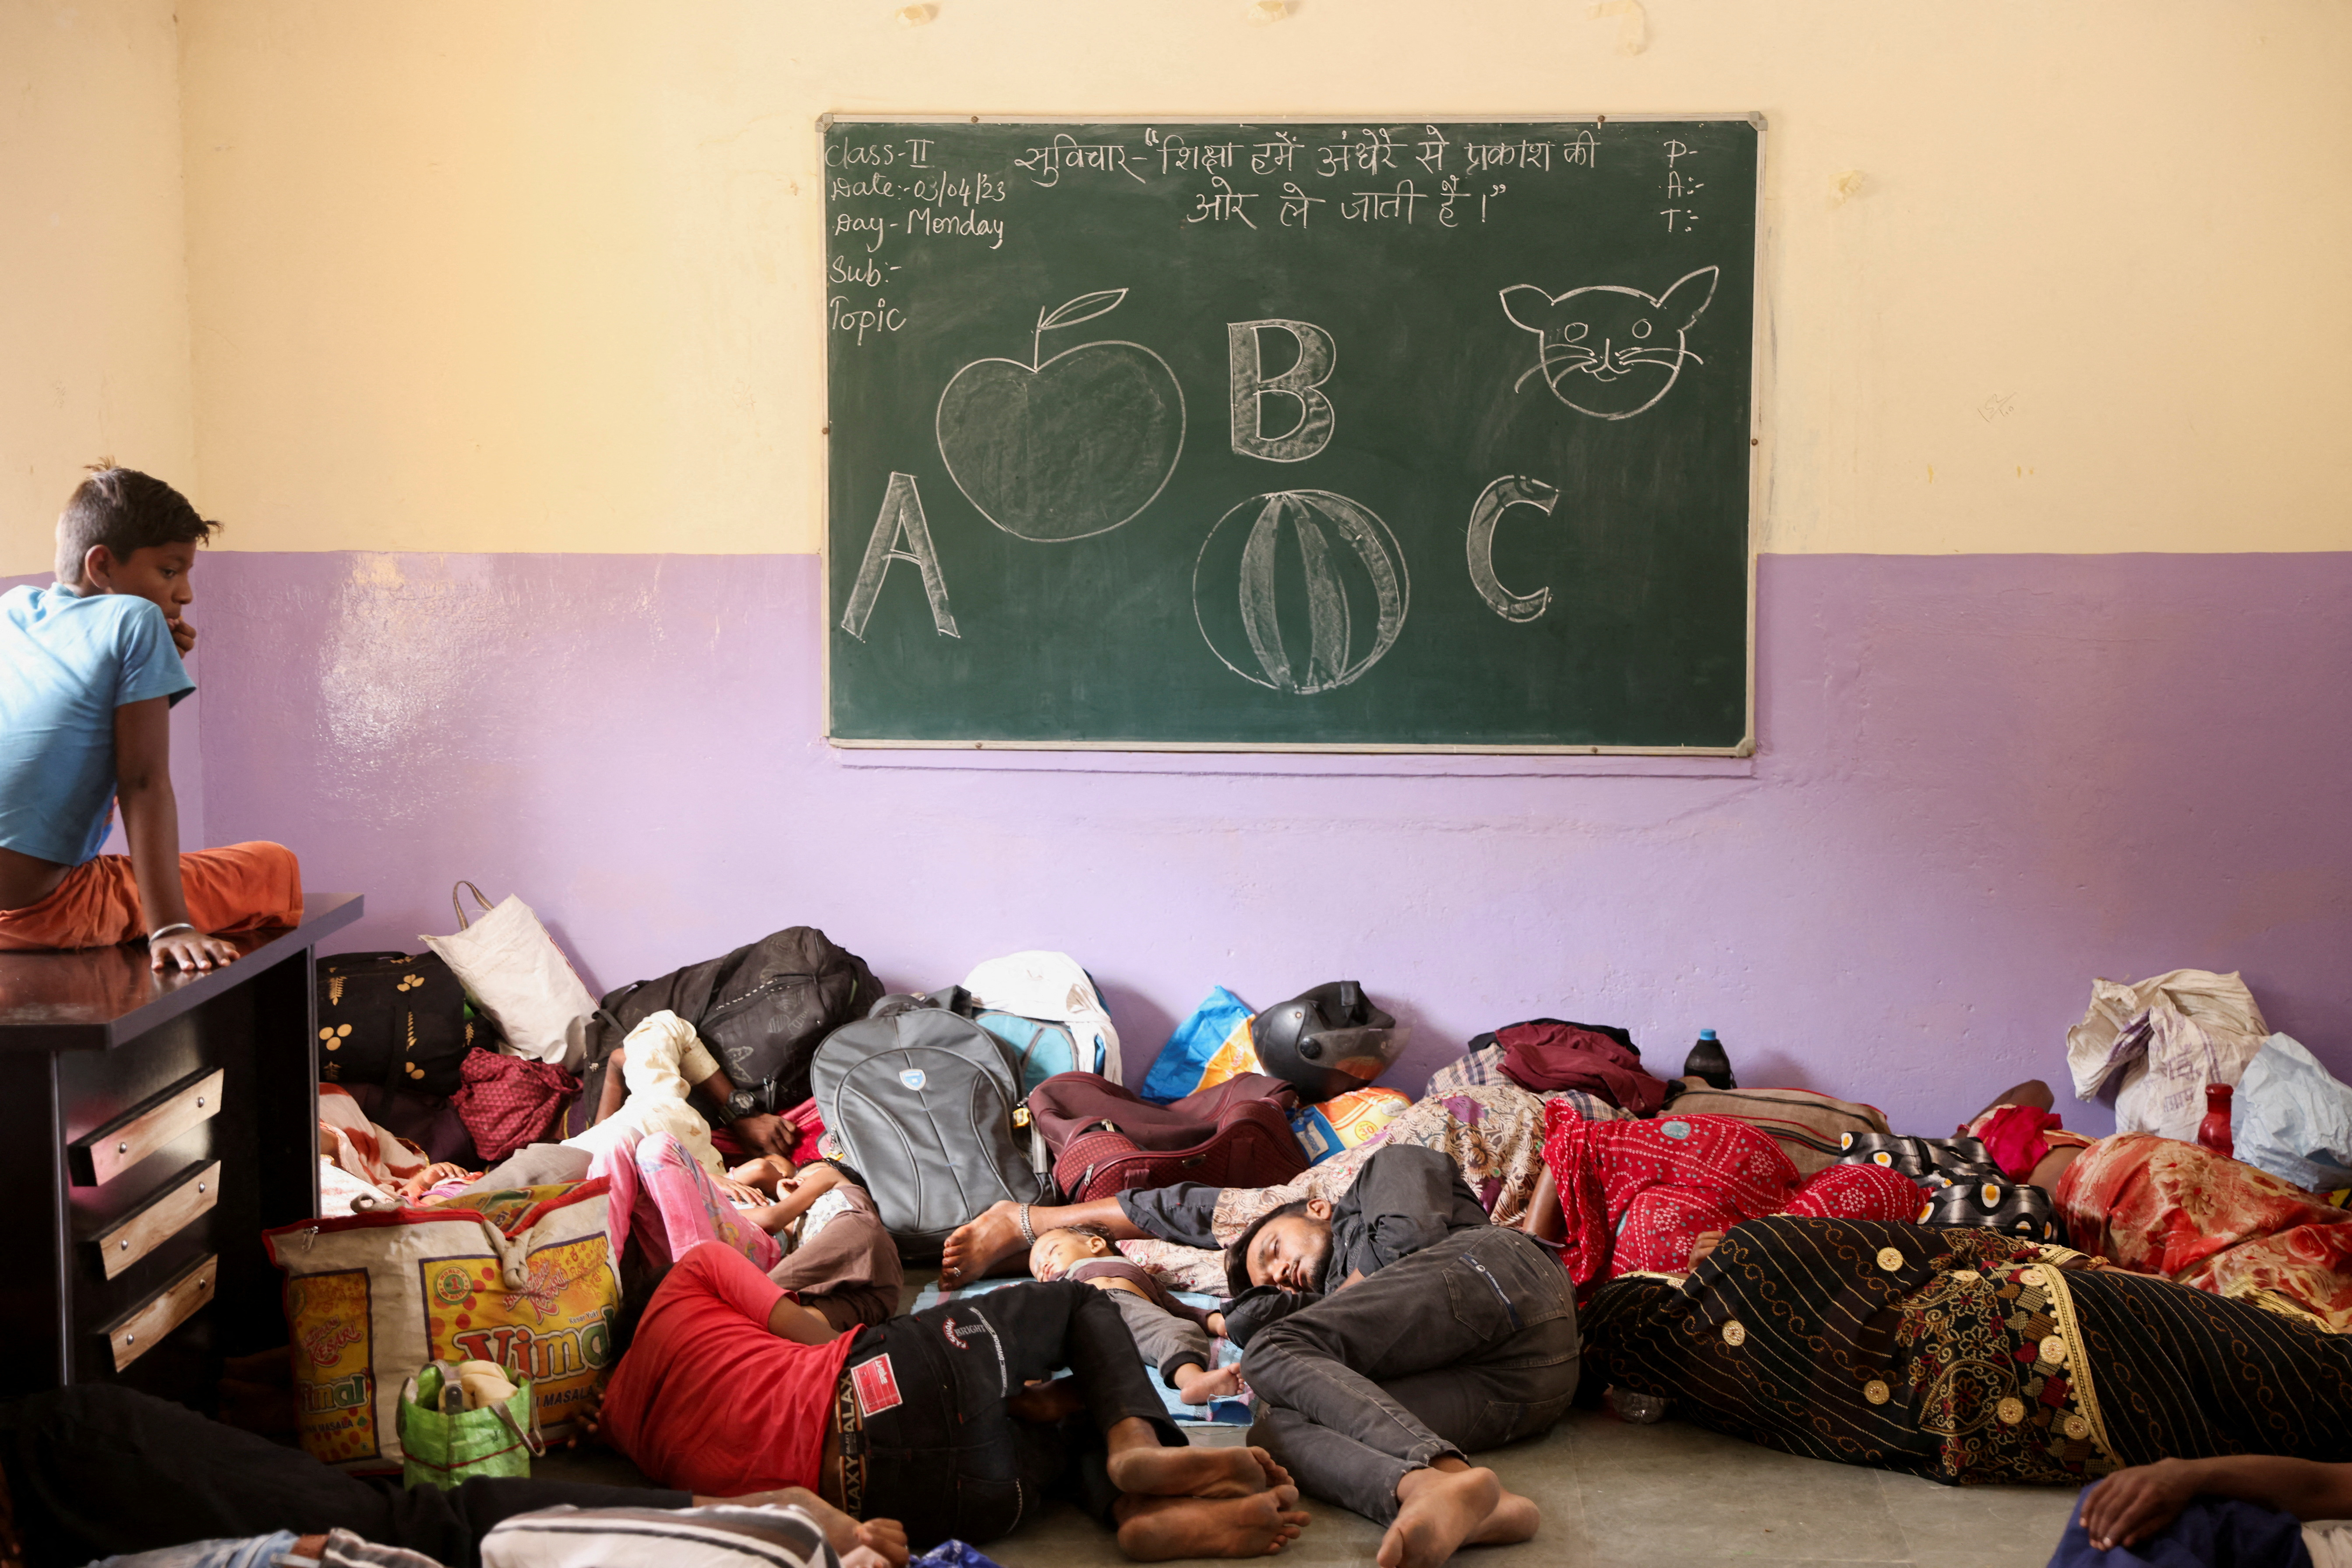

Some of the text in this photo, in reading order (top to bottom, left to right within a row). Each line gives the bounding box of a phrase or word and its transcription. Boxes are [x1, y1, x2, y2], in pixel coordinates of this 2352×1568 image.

[1251, 131, 1305, 175] हमें
[1416, 125, 1449, 174] से
[1464, 140, 1556, 175] प्रकाश
[1564, 130, 1601, 168] की
[1187, 176, 1259, 230] ओर
[1280, 182, 1326, 229] ले
[1342, 179, 1428, 224] जाती
[908, 208, 1003, 249] Monday
[830, 296, 907, 346] Topic
[1227, 319, 1336, 463] B
[842, 472, 961, 643] A
[1467, 474, 1559, 623] C
[451, 1277, 461, 1289] 1
[945, 1318, 967, 1349] FASHION
[954, 1324, 986, 1337] BRIGHT
[992, 1335, 1005, 1361] DIVISION
[841, 1374, 855, 1432] ALAX
[846, 1455, 862, 1519] ALAXY
